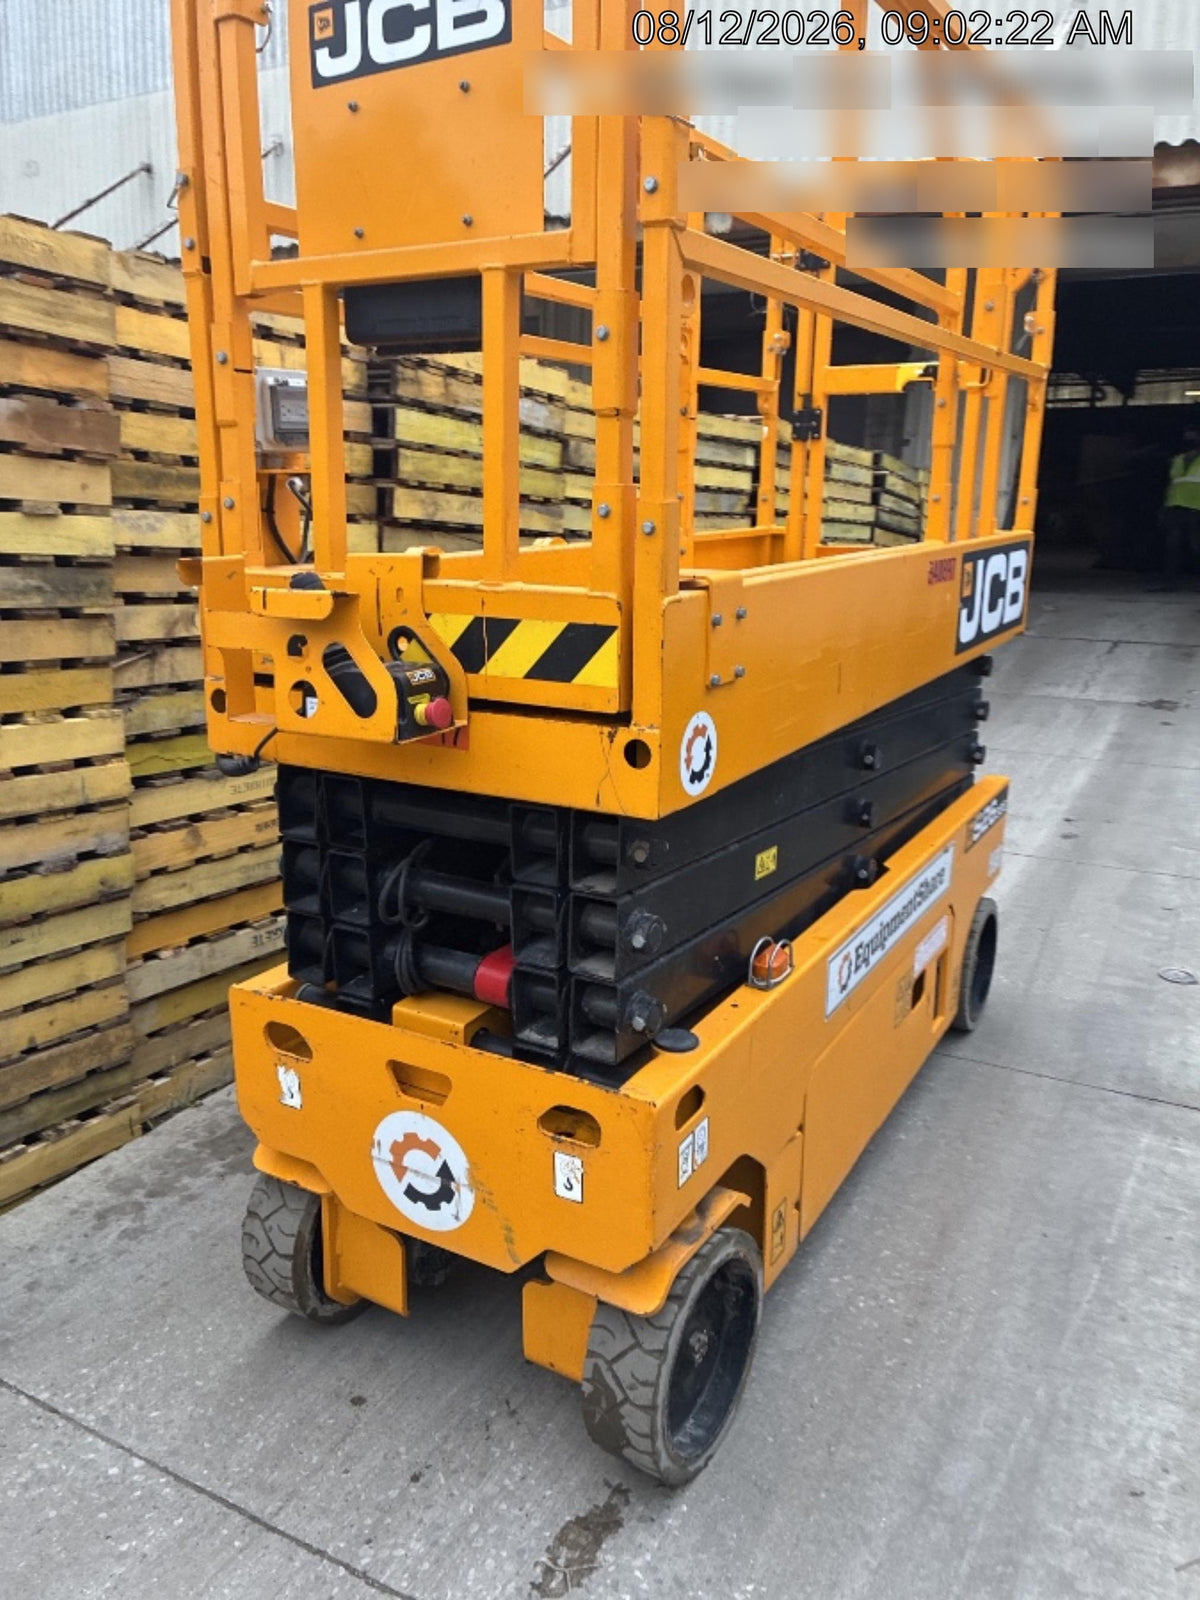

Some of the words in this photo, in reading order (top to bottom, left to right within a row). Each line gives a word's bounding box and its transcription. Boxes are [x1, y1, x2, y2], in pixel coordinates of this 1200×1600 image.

[315, 0, 506, 78] JCB
[959, 549, 1027, 643] JCB
[854, 867, 946, 974] EquipmentShare
